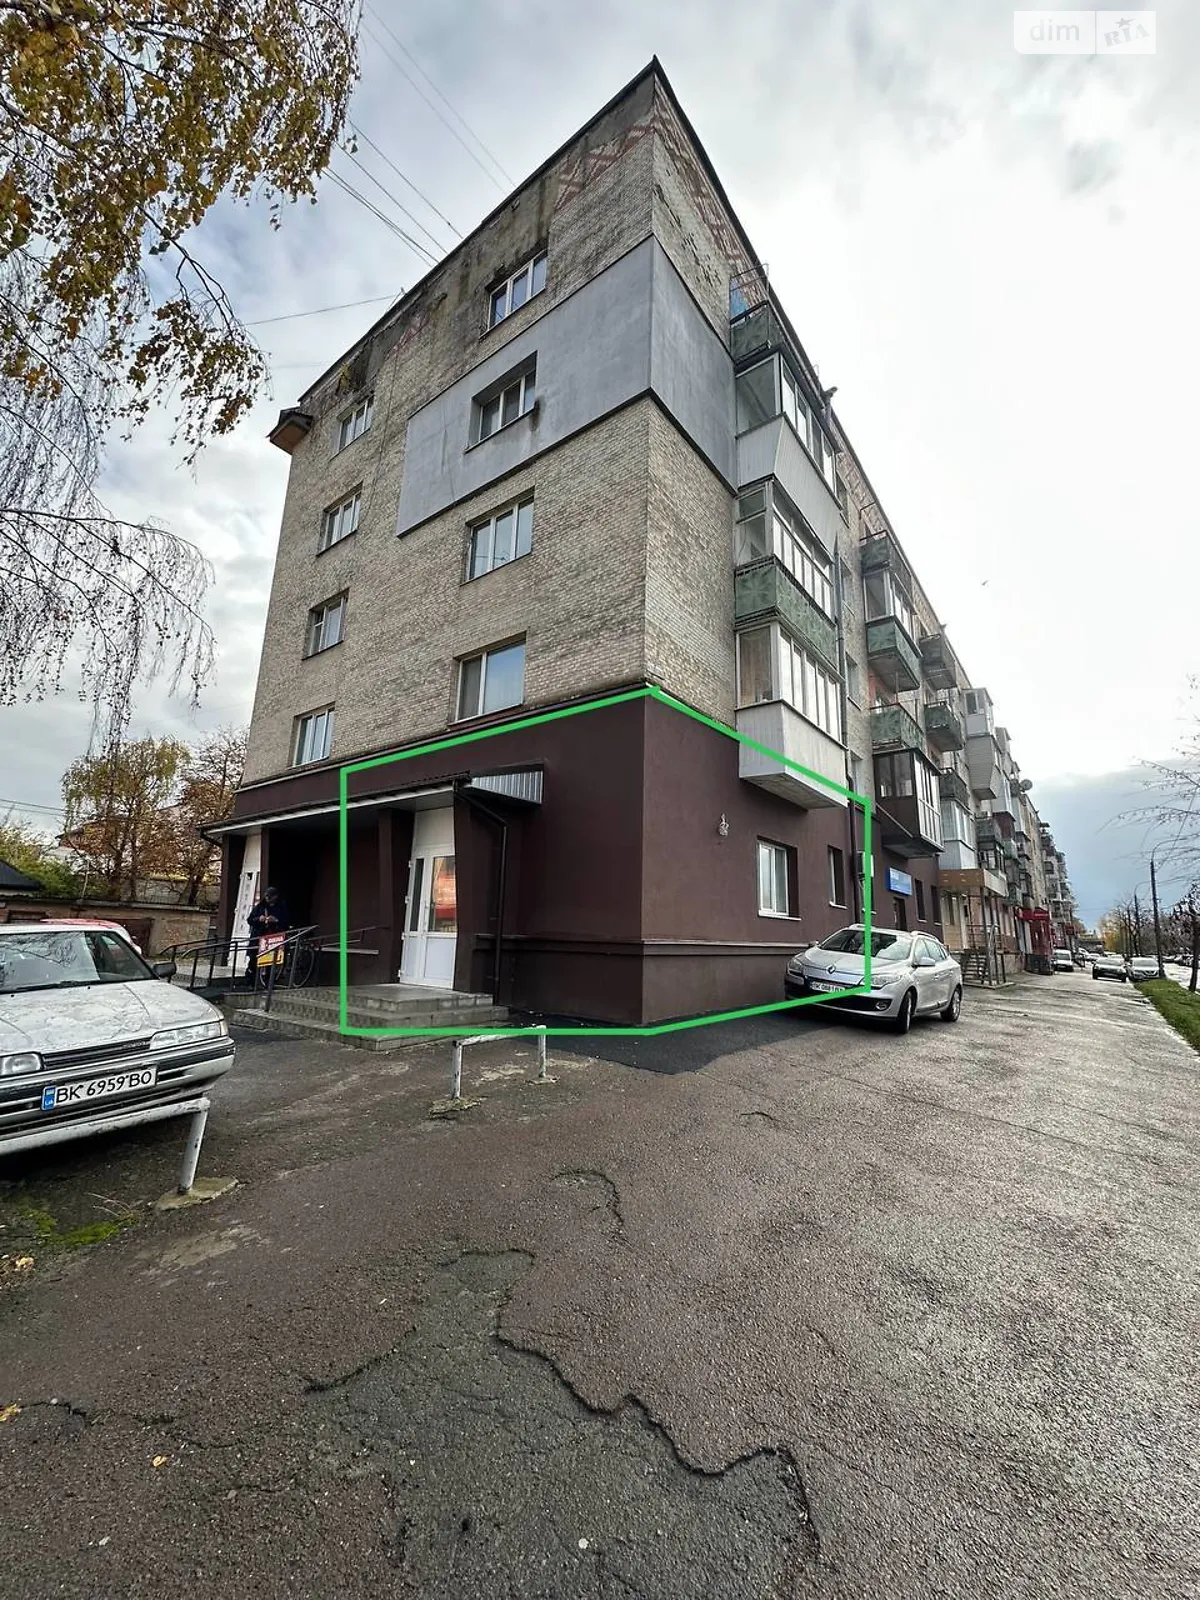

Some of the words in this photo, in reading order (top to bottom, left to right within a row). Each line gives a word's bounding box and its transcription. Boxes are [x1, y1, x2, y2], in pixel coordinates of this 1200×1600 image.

[56, 1086, 82, 1103] BK
[86, 1076, 125, 1096] 6959
[128, 1070, 152, 1088] BO
